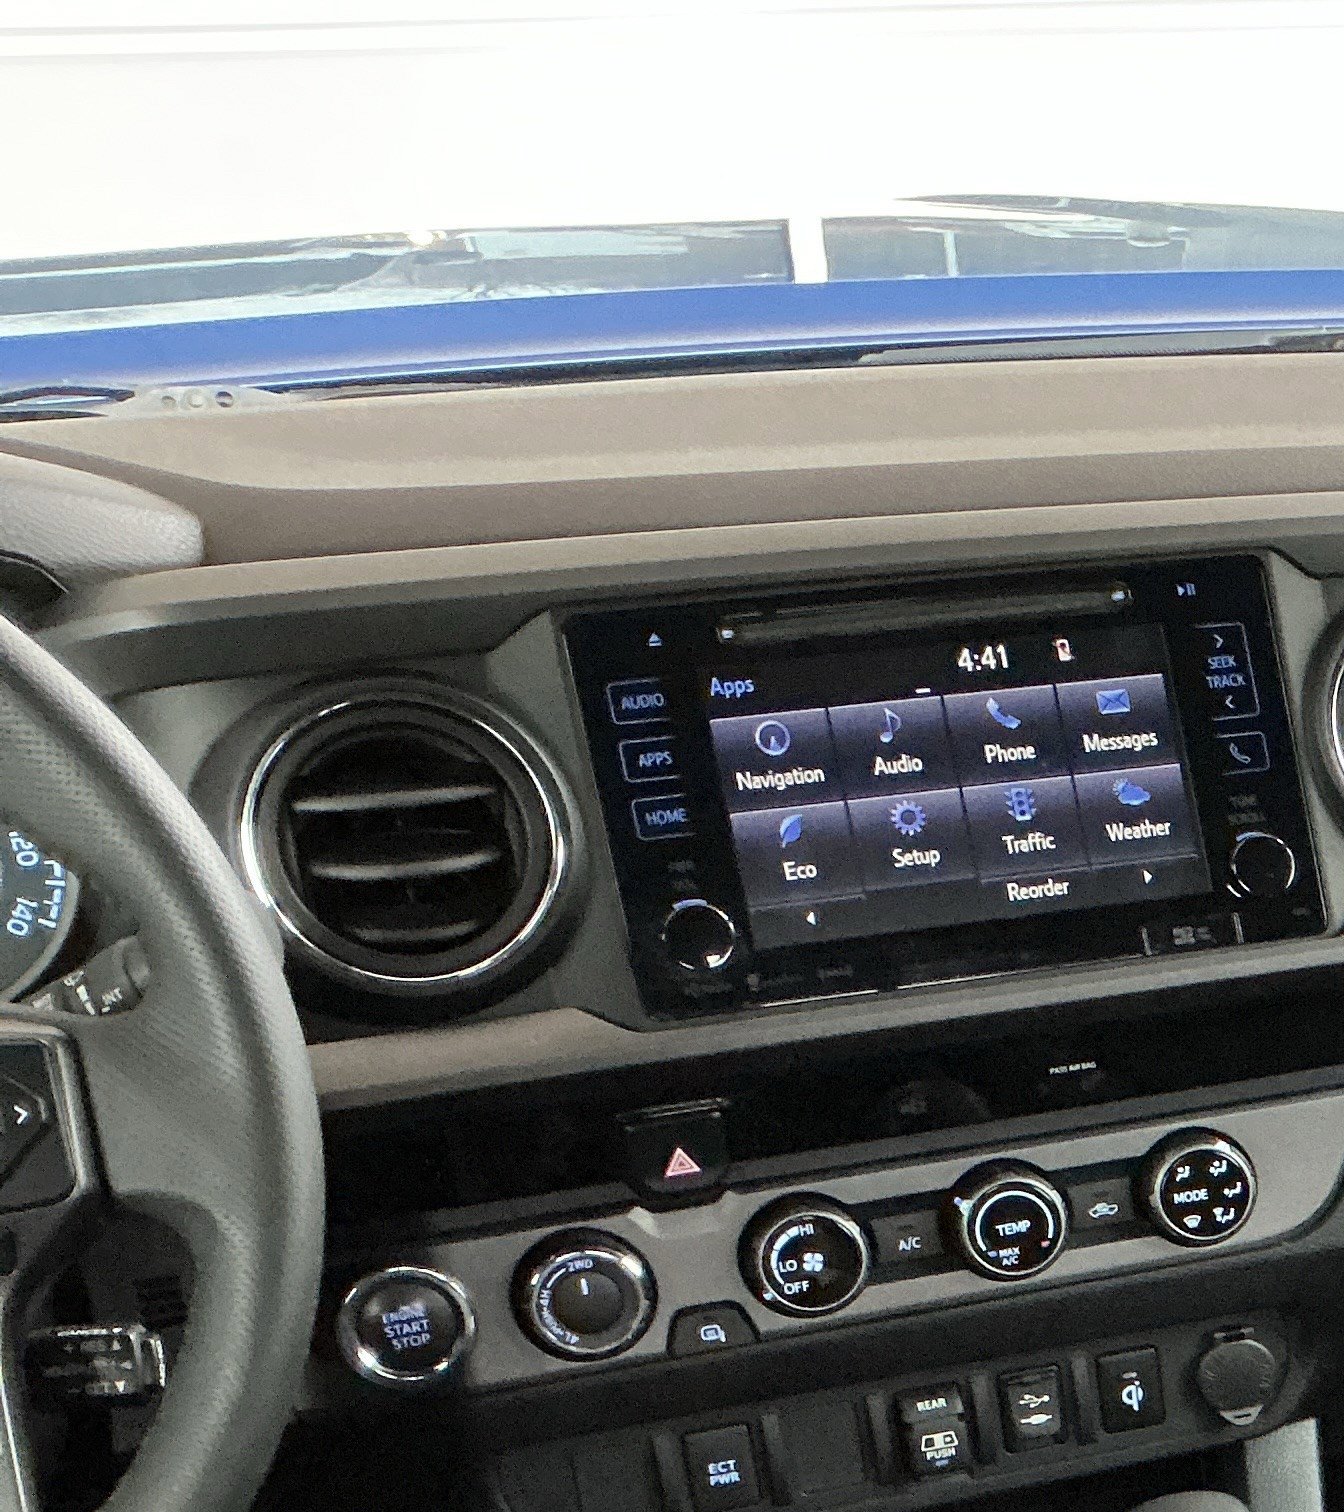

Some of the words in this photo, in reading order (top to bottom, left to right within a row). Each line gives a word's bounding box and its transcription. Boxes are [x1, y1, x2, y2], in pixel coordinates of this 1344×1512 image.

[957, 644, 1009, 672] 4:41
[1207, 655, 1236, 670] SEEK
[710, 677, 755, 698] Apps
[1206, 674, 1247, 689] TRACK
[621, 692, 665, 711] AUDIO
[1082, 731, 1159, 754] Messages
[638, 750, 674, 769] APPS
[984, 743, 1037, 765] Phone
[873, 753, 923, 776] Audio
[735, 767, 826, 791] Navigation
[645, 806, 689, 827] HOME
[1105, 819, 1171, 842] Weather
[1001, 831, 1056, 855] Traffic
[892, 848, 941, 868] Setup
[783, 861, 818, 881] Eco
[1006, 879, 1070, 902] Reorder
[6, 896, 39, 936] 140
[1173, 1188, 1209, 1204] MODE
[799, 1223, 815, 1236] HI
[995, 1219, 1031, 1236] TEMP
[899, 1235, 922, 1251] A/C
[999, 1246, 1020, 1258] MAX
[566, 1259, 594, 1273] 2WD
[778, 1259, 798, 1273] LO
[783, 1280, 810, 1295] OFF
[384, 1319, 429, 1338] START
[392, 1333, 431, 1349] STOP
[916, 1397, 948, 1412] REAR
[926, 1447, 957, 1461] PUSH
[708, 1459, 737, 1474] ECT
[709, 1471, 741, 1487] PWR
